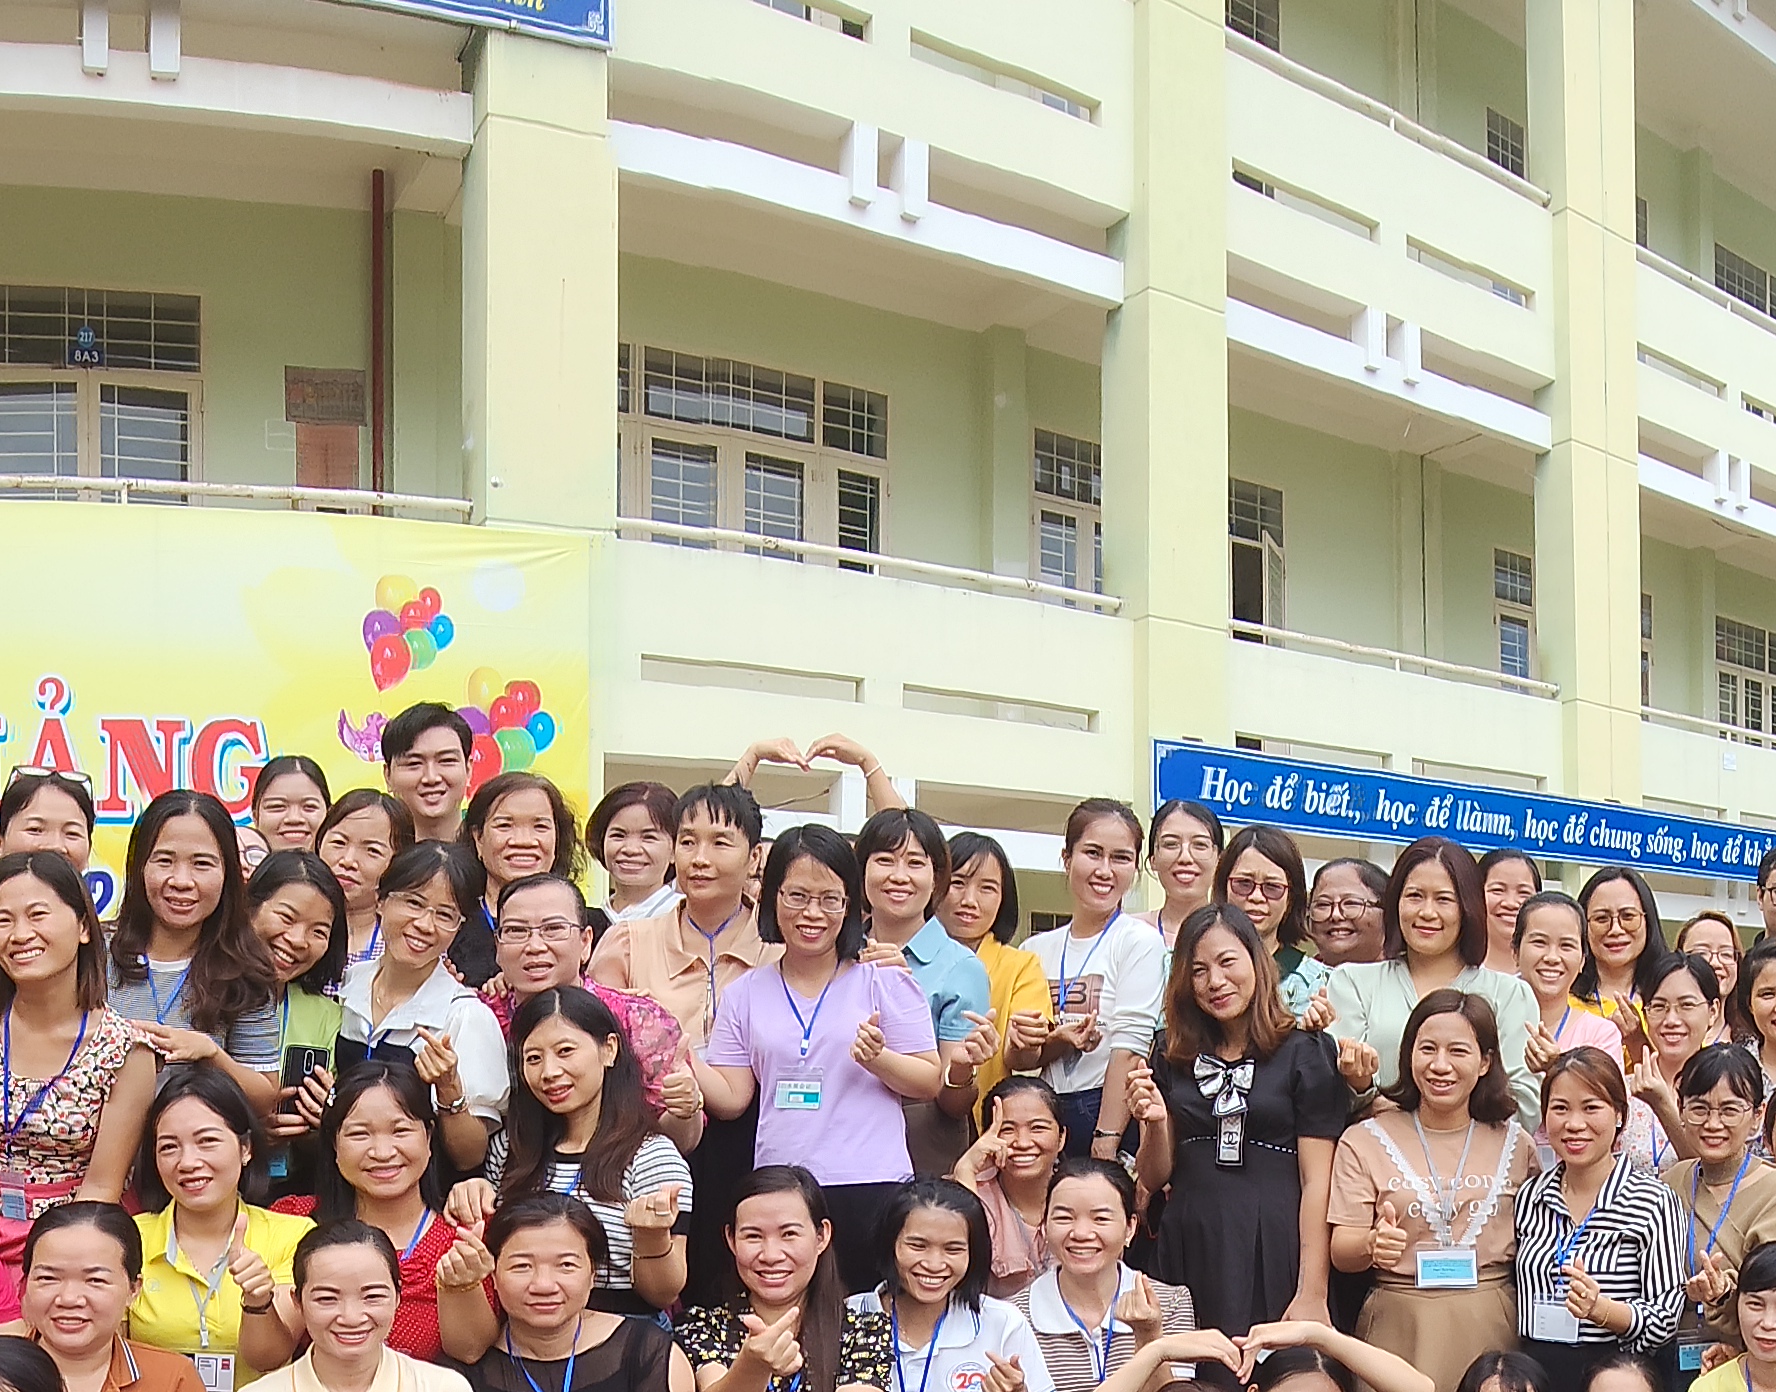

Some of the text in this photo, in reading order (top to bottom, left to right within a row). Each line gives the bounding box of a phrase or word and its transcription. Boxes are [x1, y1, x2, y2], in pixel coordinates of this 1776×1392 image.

[79, 331, 93, 342] 217
[74, 350, 99, 362] 8A3
[1200, 765, 1254, 812] Học
[1265, 773, 1299, 810] để
[1376, 788, 1417, 830] học
[1425, 793, 1456, 828] để
[1524, 808, 1558, 848] học
[1563, 811, 1590, 846] để
[1589, 818, 1643, 860] chung
[1646, 825, 1688, 863] sống,
[1690, 832, 1720, 868] học
[1722, 833, 1744, 867] để
